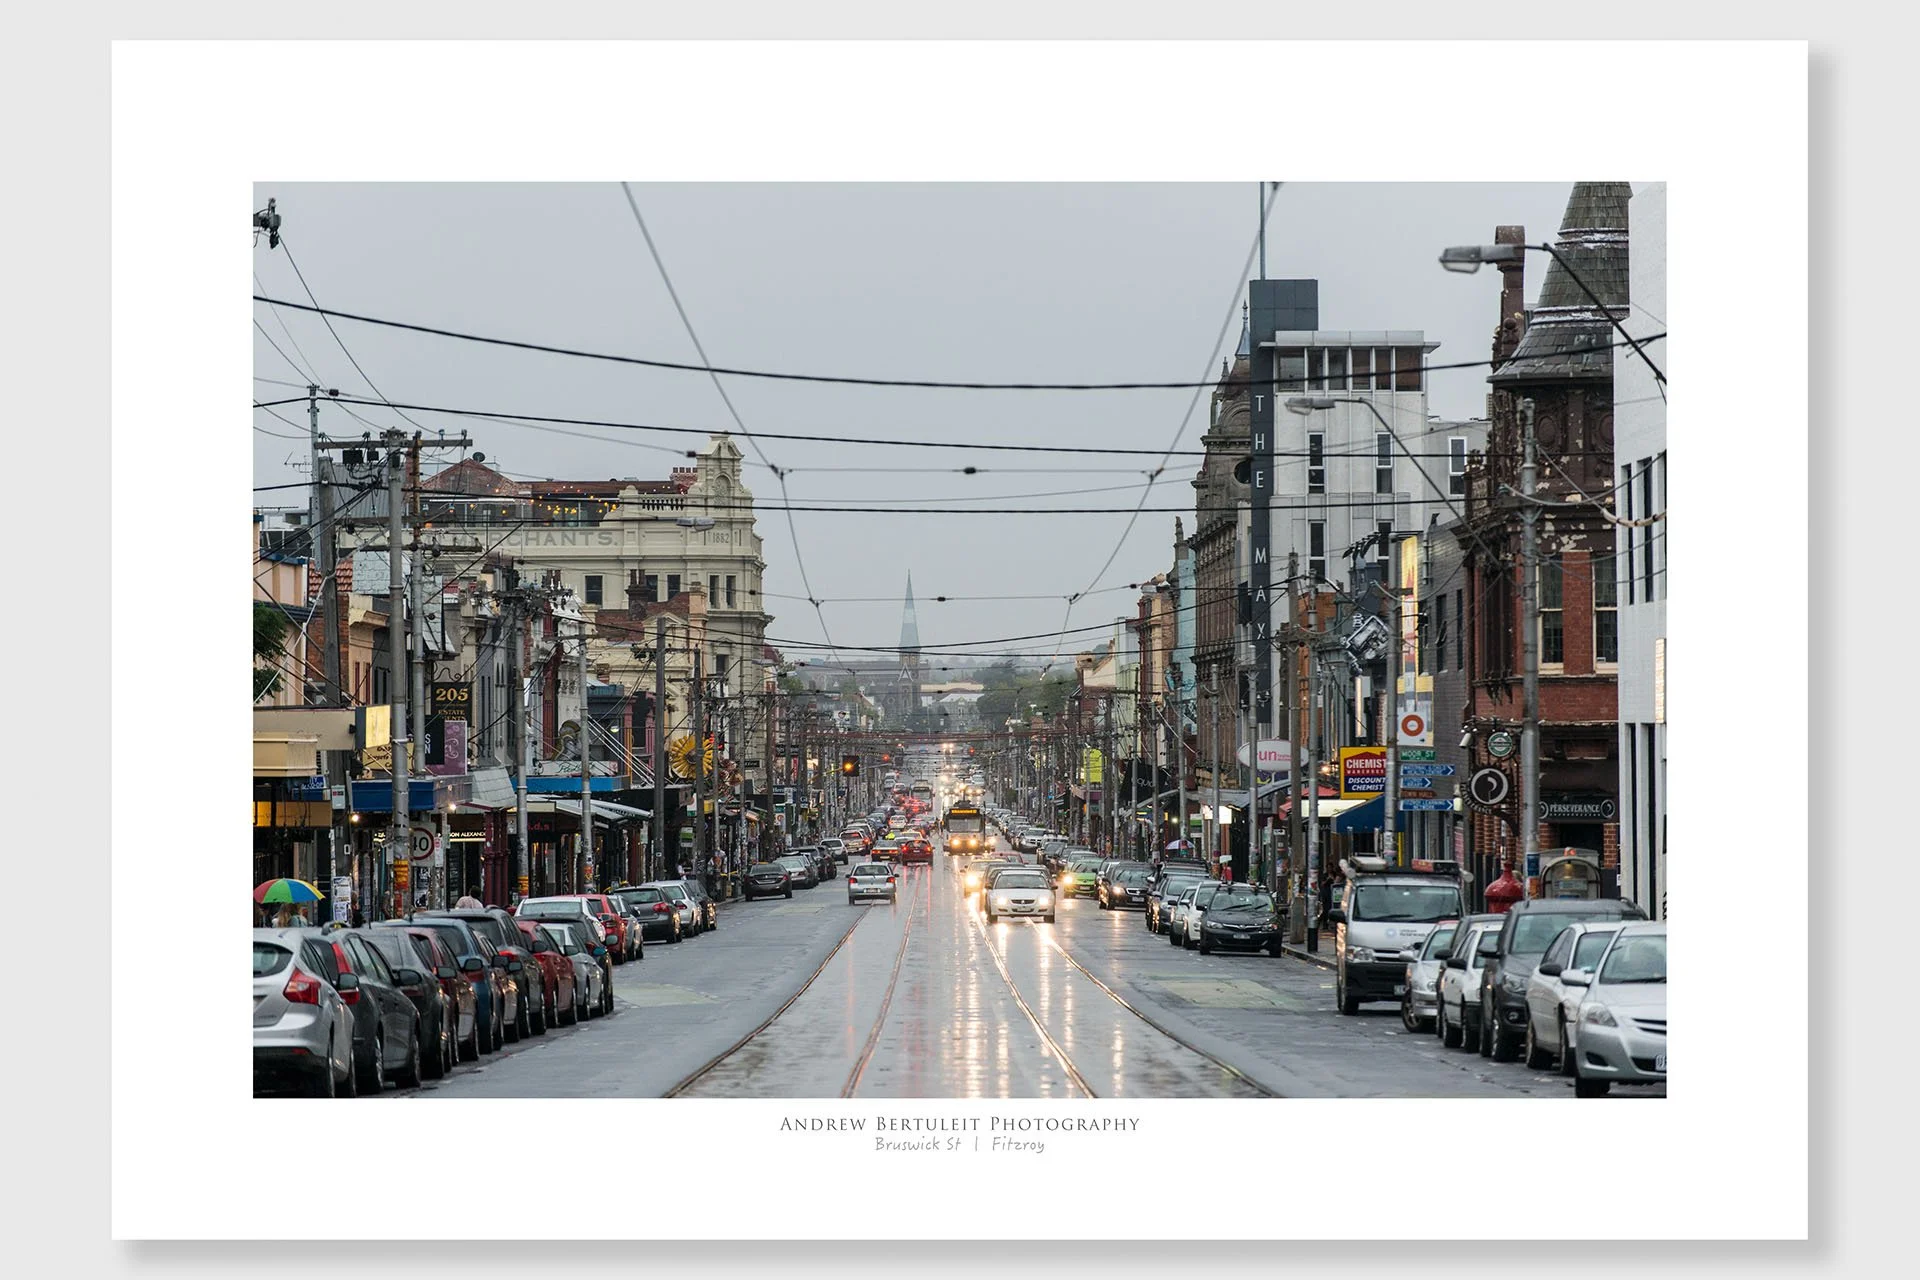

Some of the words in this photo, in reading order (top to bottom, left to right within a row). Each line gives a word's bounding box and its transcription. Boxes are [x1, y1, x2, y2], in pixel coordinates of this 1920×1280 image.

[1255, 394, 1265, 489] THE
[711, 532, 730, 544] 1882
[435, 688, 469, 701] 205
[1346, 758, 1387, 769] CHEMIST
[1549, 803, 1600, 812] PERSEVERANCE
